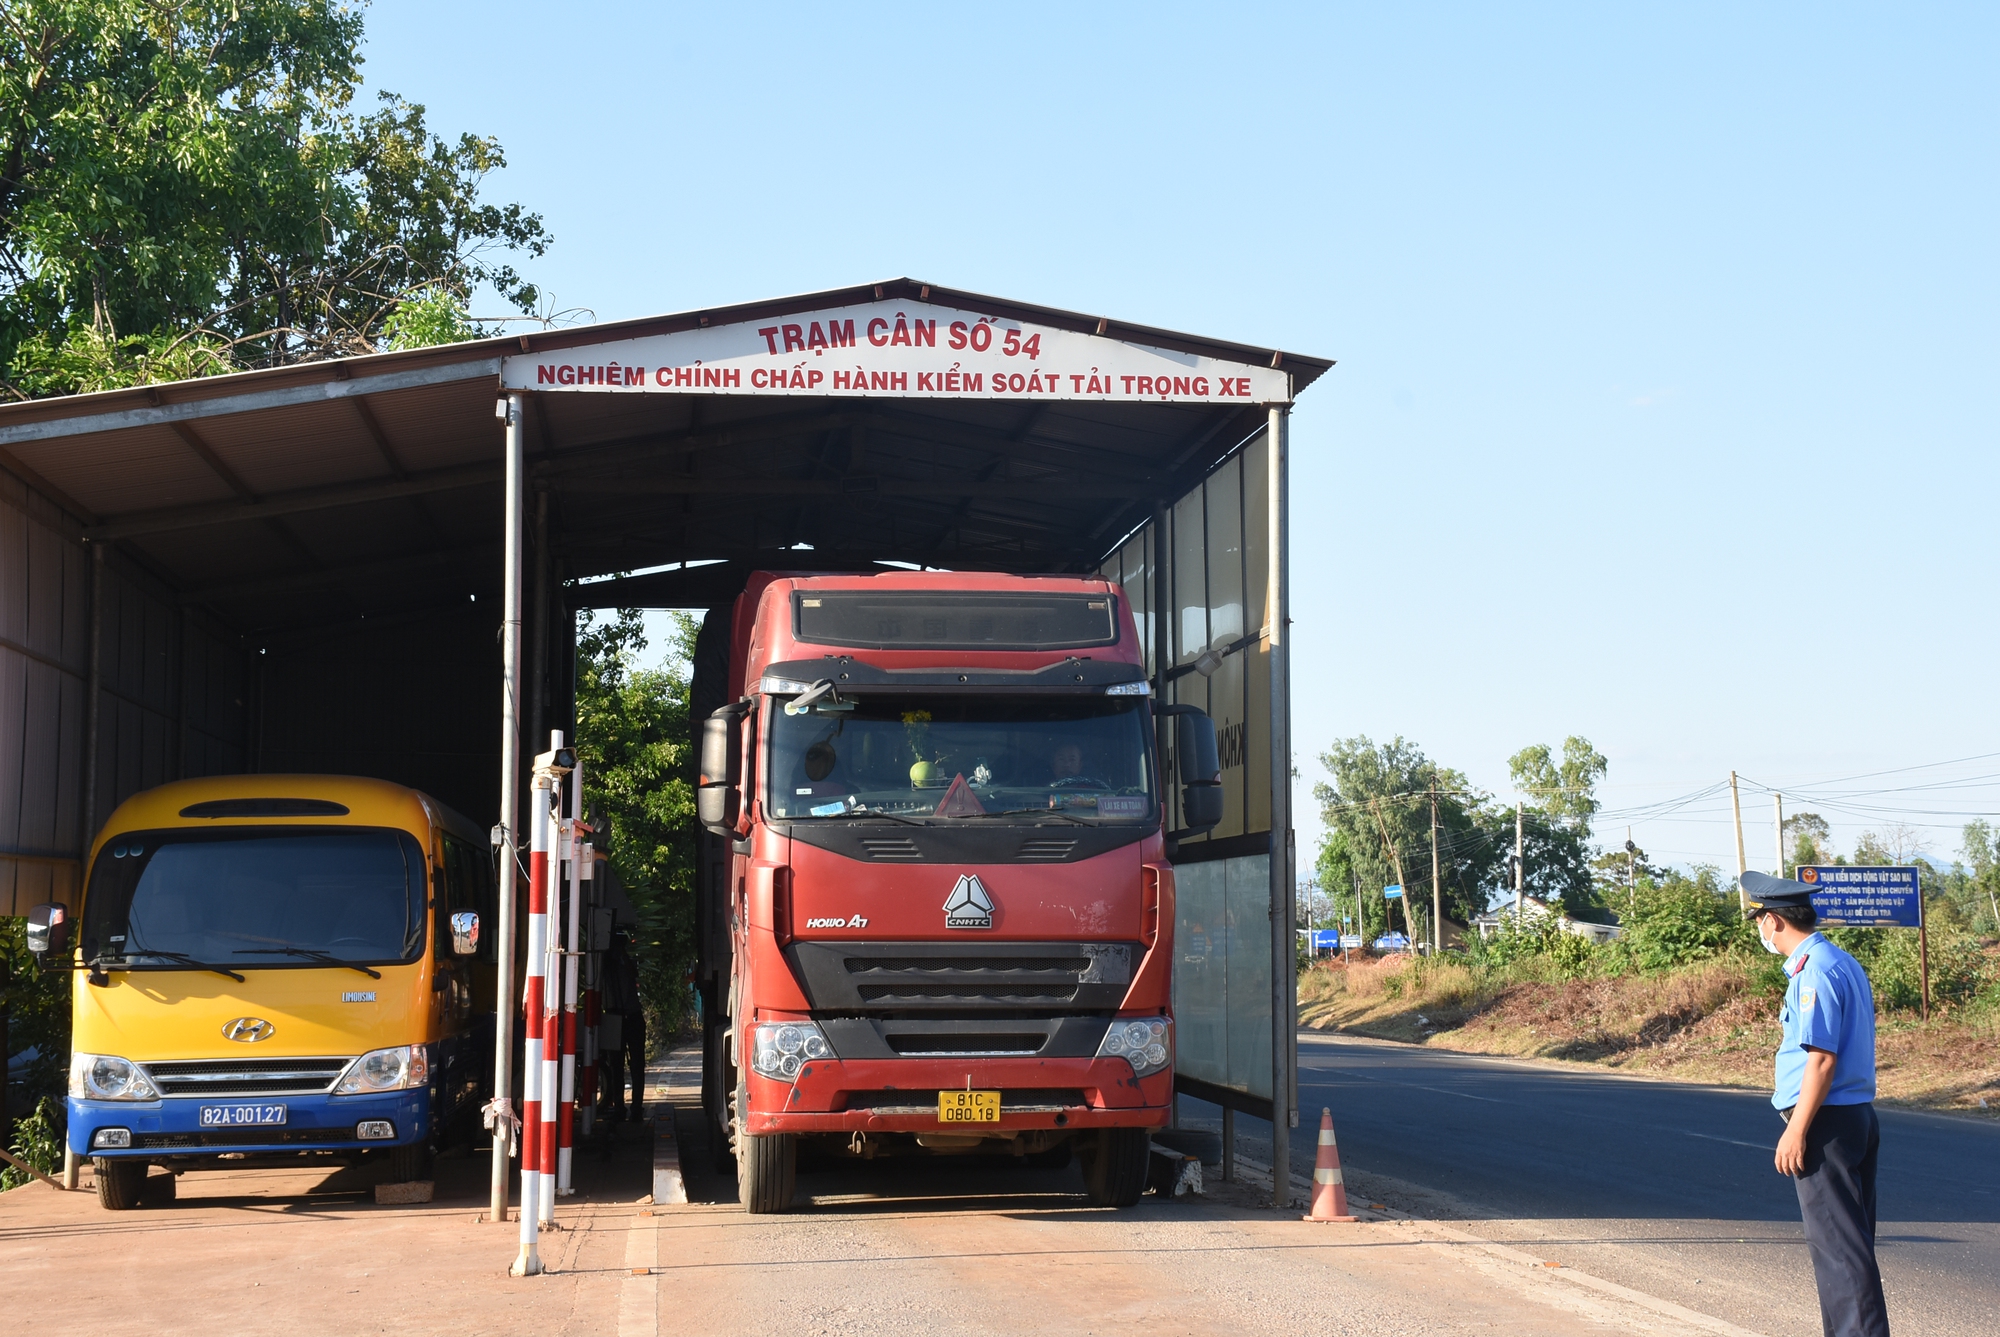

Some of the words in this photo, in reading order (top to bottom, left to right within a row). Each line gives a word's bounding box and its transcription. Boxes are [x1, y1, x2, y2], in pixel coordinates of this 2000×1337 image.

[758, 318, 856, 357] TRẠM
[866, 312, 936, 348] CÂN
[948, 317, 999, 353] SỐ
[1002, 328, 1041, 361] 54
[537, 361, 645, 387] NGHIÊM
[655, 359, 741, 388] CHỈNH
[750, 361, 824, 389] CHẤP
[833, 365, 907, 391] HÀNH
[917, 362, 983, 393] KIỂM
[992, 368, 1060, 394] SOÁT
[1069, 366, 1111, 395] TẢI
[1121, 374, 1209, 400] TRỌNG
[1218, 377, 1251, 397] XE
[1113, 801, 1120, 810] XE
[1121, 801, 1128, 810] AN
[1820, 872, 1834, 884] TRẠM
[1878, 870, 1889, 884] VẬT
[1890, 872, 1901, 882] SAO
[1824, 885, 1837, 895] CÁC
[1861, 885, 1875, 897] TIỆN
[1876, 885, 1889, 897] VẬN
[1830, 896, 1841, 907] VẬT
[1892, 897, 1905, 907] VẬT
[342, 991, 377, 1003] LIMOUSINE
[957, 1093, 983, 1106] 81C
[203, 1106, 283, 1124] 82A-001.27
[946, 1108, 993, 1120] 080.18
